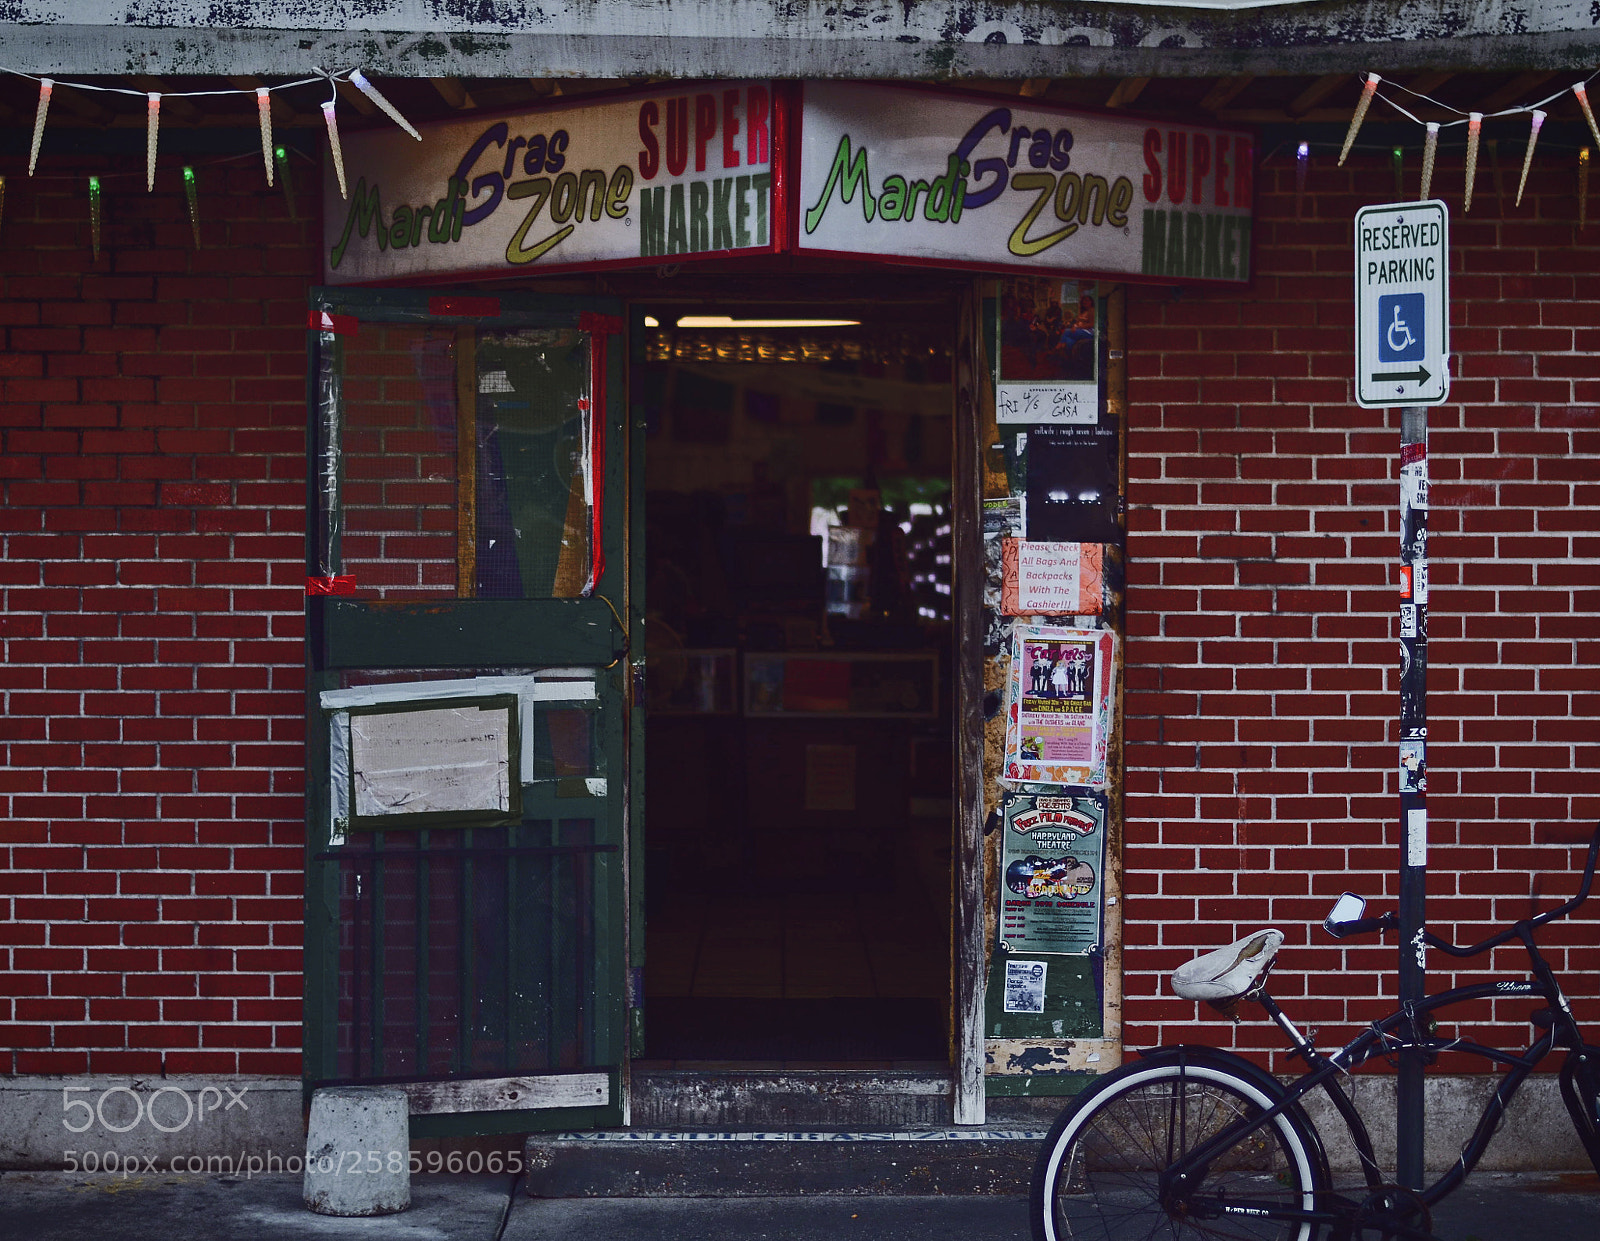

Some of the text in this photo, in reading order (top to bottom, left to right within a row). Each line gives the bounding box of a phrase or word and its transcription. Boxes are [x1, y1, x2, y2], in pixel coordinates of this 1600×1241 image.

[638, 85, 770, 180] SUPER
[805, 108, 1074, 234] Mardi Gras
[1142, 128, 1253, 209] SUPER
[330, 122, 570, 269] Mardi Gras
[506, 165, 634, 264] Zone
[639, 172, 771, 257] MARKET
[1007, 172, 1134, 257] Zone
[1141, 208, 1252, 282] MARKET
[1363, 222, 1440, 252] RESERVED
[1368, 257, 1435, 285] PARKING
[998, 391, 1018, 418] FRI
[1021, 543, 1078, 552] Please Check
[1021, 557, 1078, 566] All Bags And
[1026, 572, 1073, 580] Backpacks
[1026, 600, 1071, 608] Cashier!!!
[1029, 586, 1070, 595] With The
[1030, 646, 1085, 660] Carvels
[1039, 812, 1063, 824] FILM
[1032, 832, 1076, 840] HAPPYLAND
[1038, 841, 1071, 850] THEATRE
